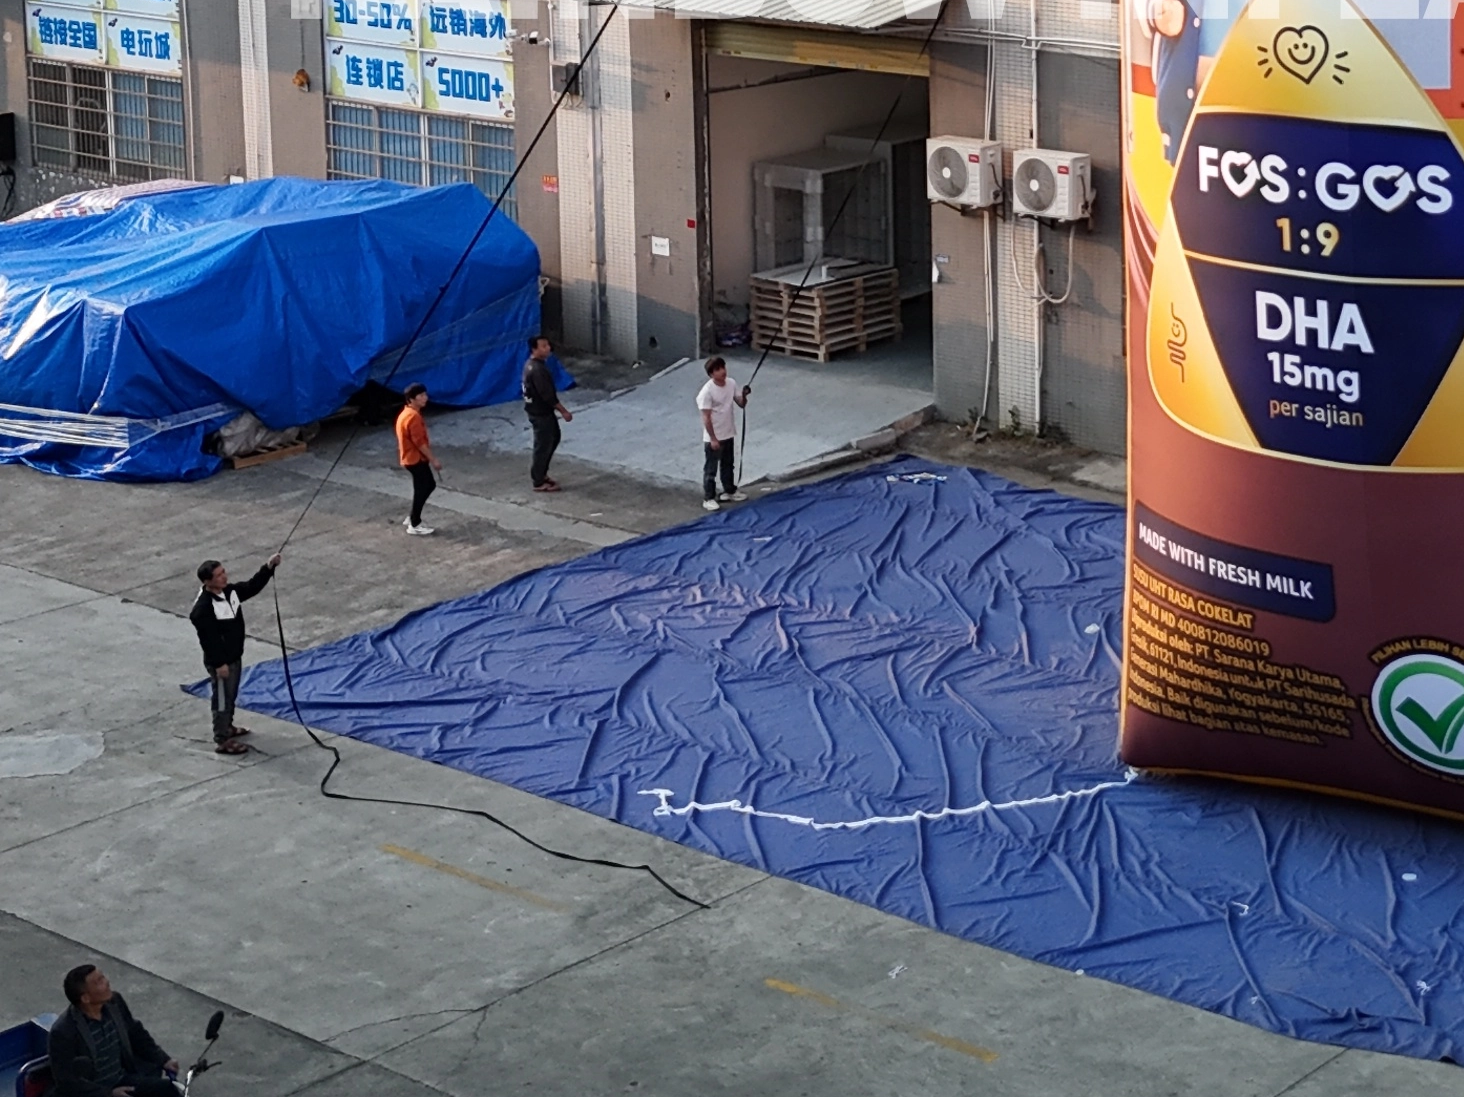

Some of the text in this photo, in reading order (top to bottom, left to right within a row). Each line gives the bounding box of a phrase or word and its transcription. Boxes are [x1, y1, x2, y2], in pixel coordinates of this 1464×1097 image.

[429, 5, 507, 40] 远销海外
[120, 27, 170, 60] 电玩城
[346, 55, 405, 91] 连锁店
[438, 67, 504, 102] 5000+
[1276, 217, 1340, 256] 1:9
[1255, 290, 1375, 354] DHA
[1267, 351, 1360, 402] 15mg
[1269, 399, 1363, 428] per sajian
[1139, 522, 1314, 600] MADE WITH FRESH MILK
[1149, 576, 1167, 599] UHT
[1168, 586, 1196, 612] RASA
[1197, 599, 1253, 629] COKELAT
[1177, 618, 1270, 656] 400812086019
[1413, 639, 1449, 652] LEBIH
[1213, 649, 1255, 671] Sarana
[1257, 660, 1295, 679] Karya
